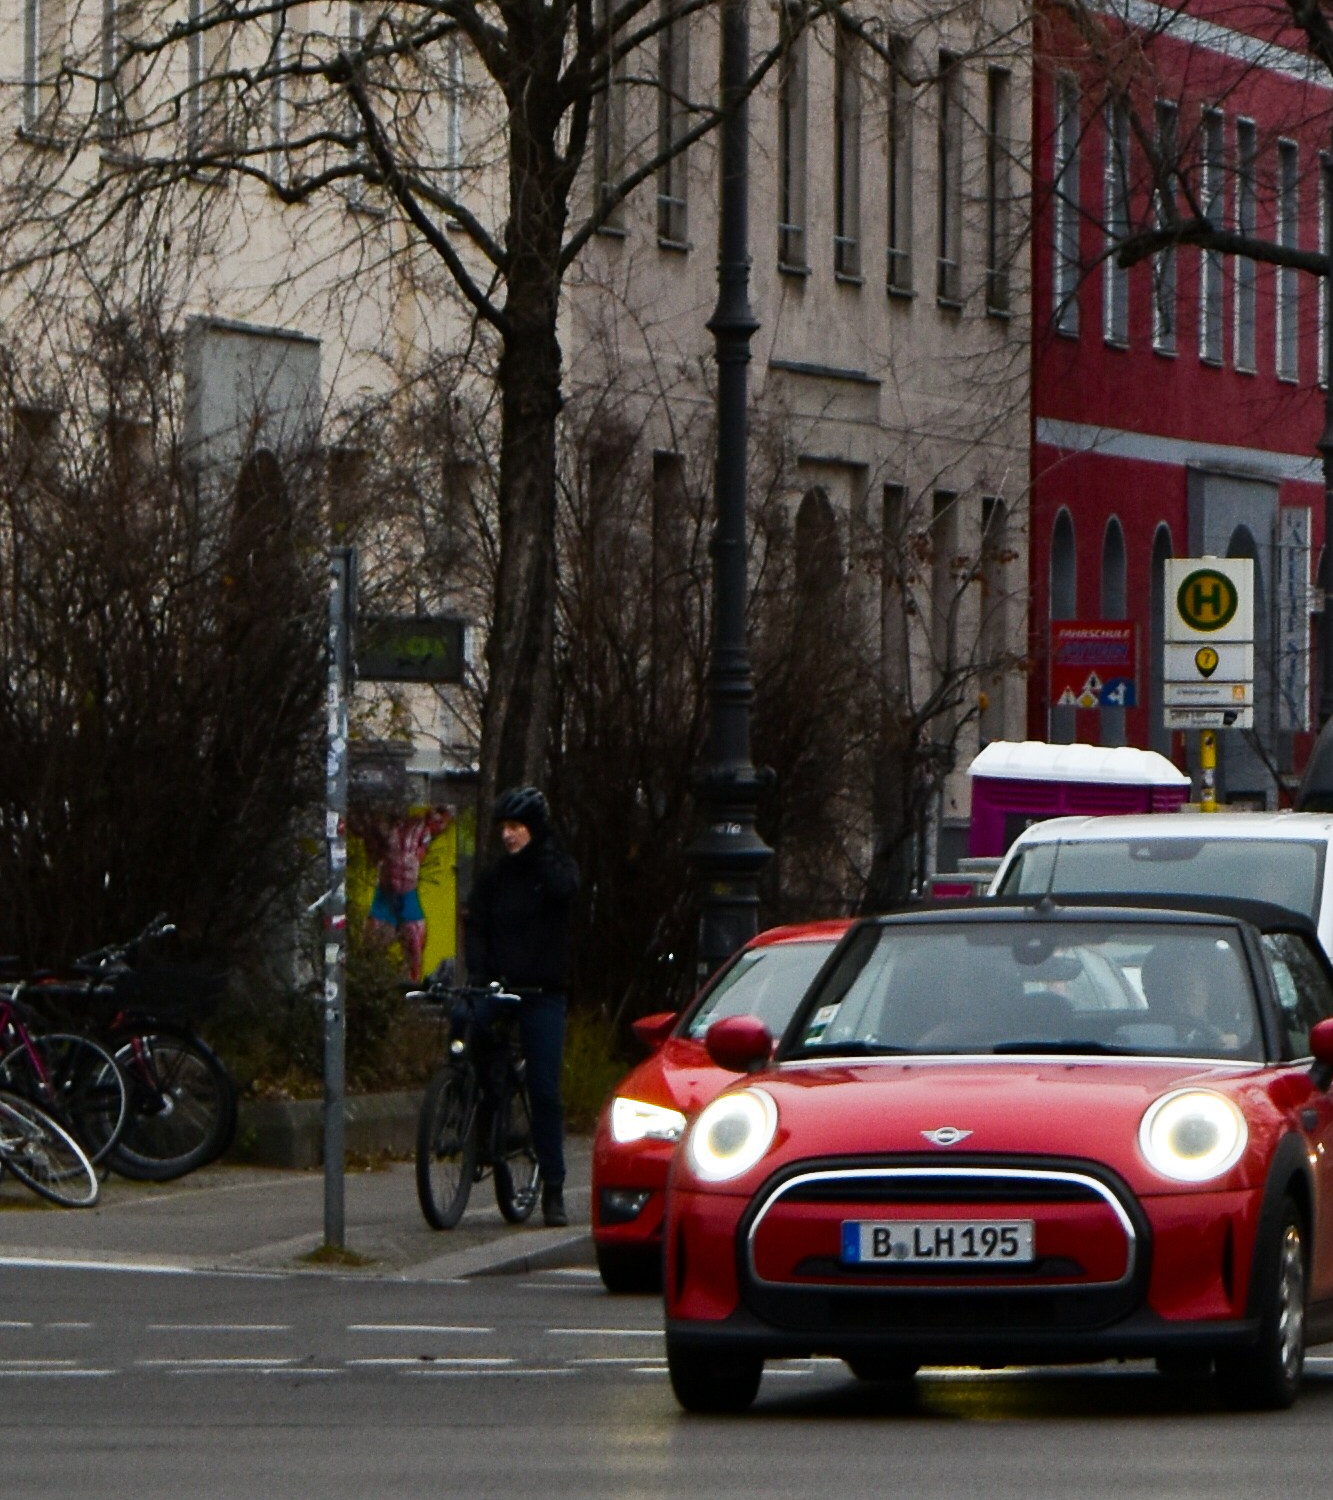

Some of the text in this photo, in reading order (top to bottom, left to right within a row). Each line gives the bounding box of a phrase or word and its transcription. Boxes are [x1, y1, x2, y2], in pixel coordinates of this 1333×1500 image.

[1193, 583, 1221, 616] H
[872, 1226, 1019, 1257] B LH 195
